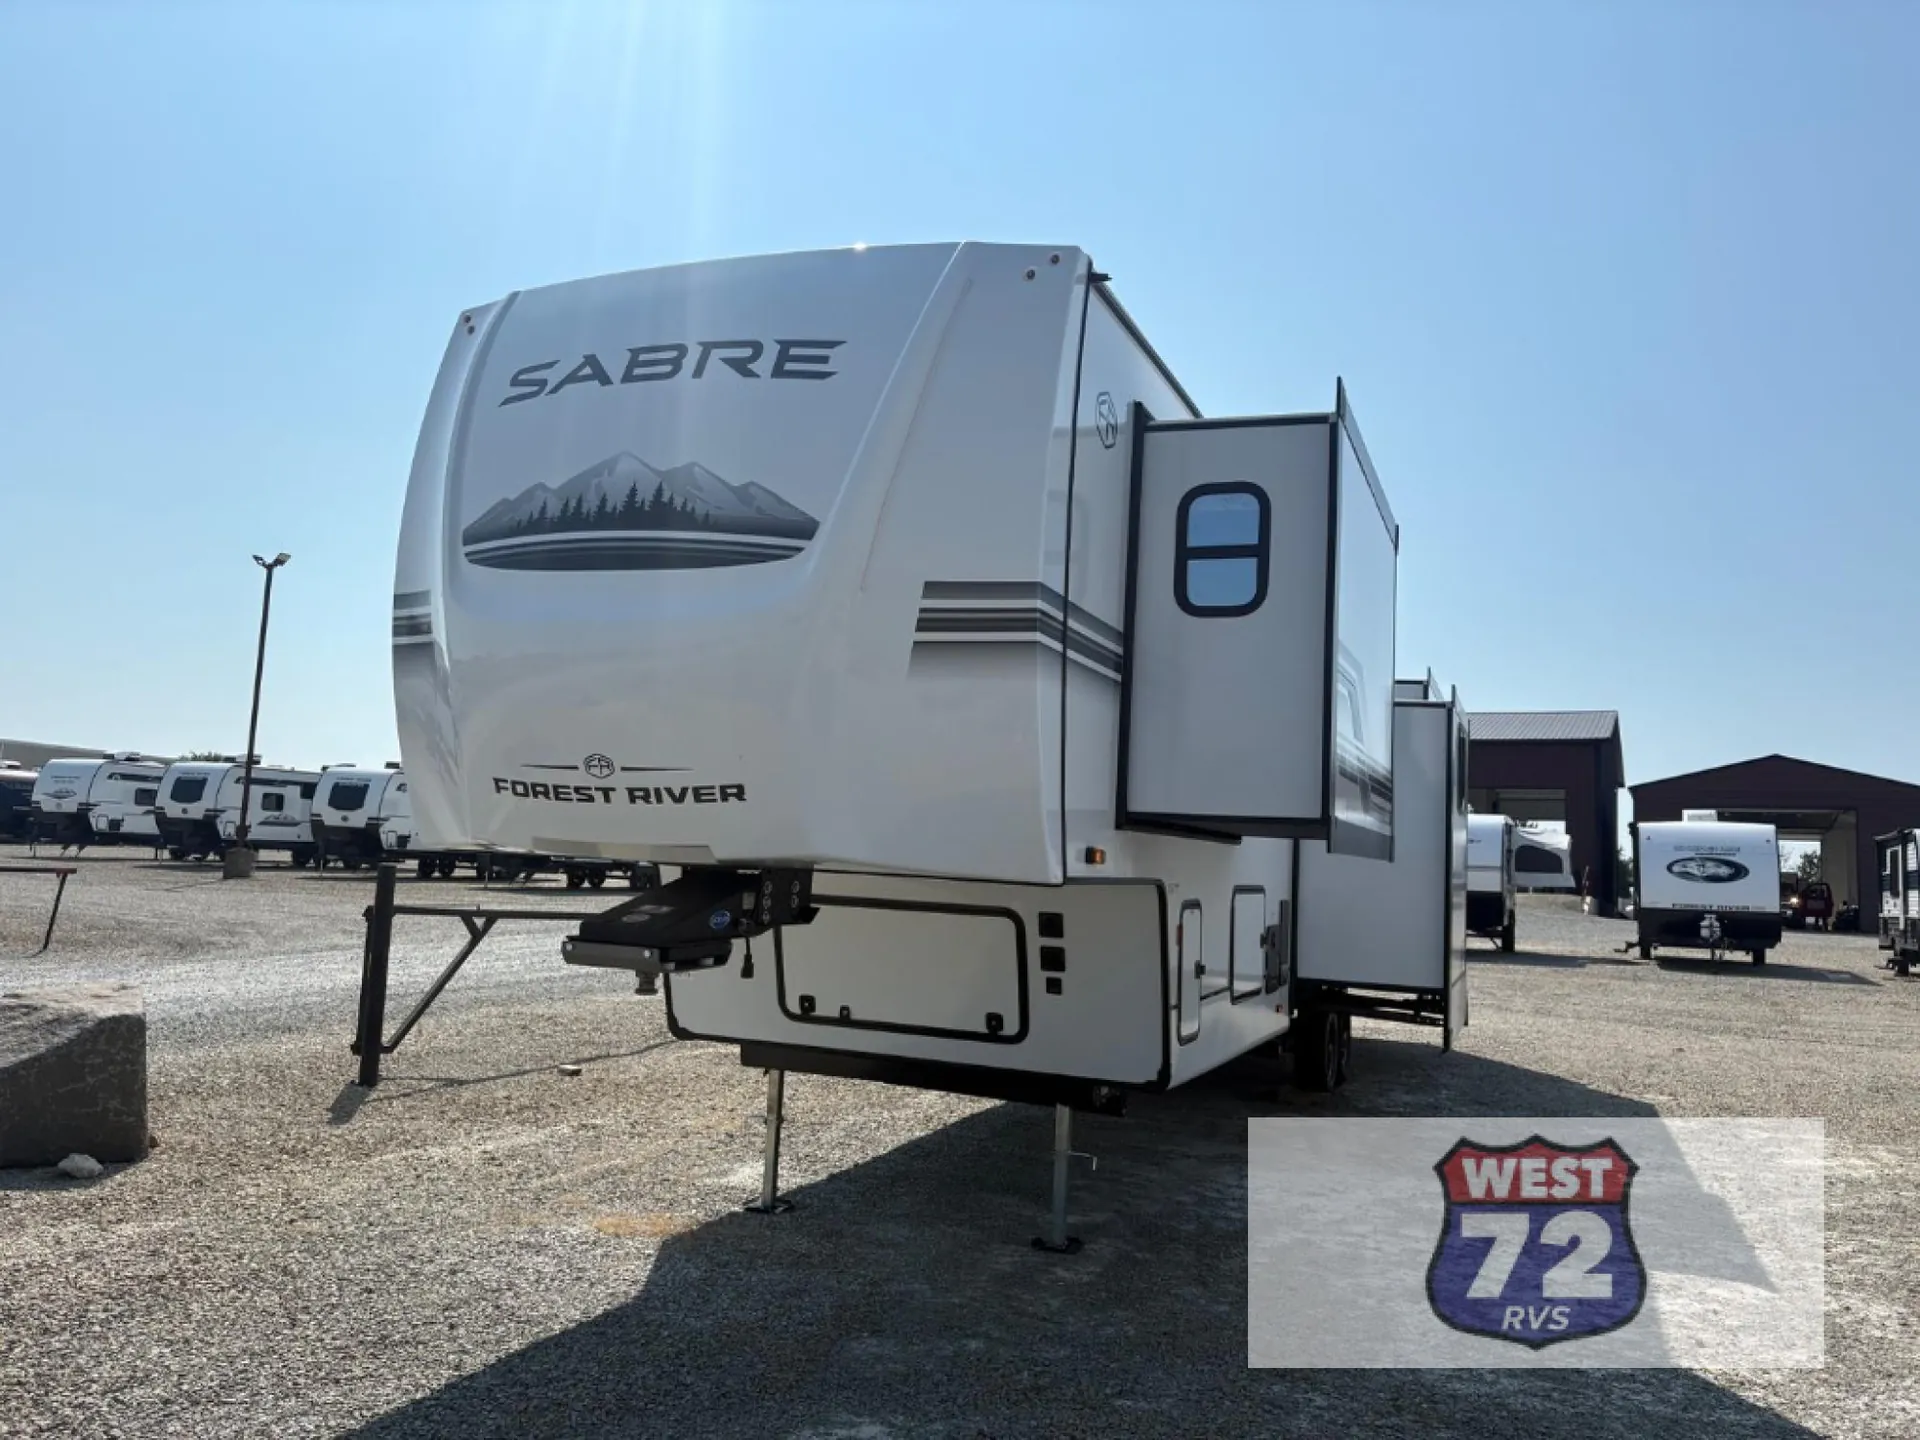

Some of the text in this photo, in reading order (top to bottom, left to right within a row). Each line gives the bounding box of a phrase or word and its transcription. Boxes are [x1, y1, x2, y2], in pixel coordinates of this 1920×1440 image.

[498, 339, 848, 408] SABRE
[492, 777, 748, 805] FOREST RIVER
